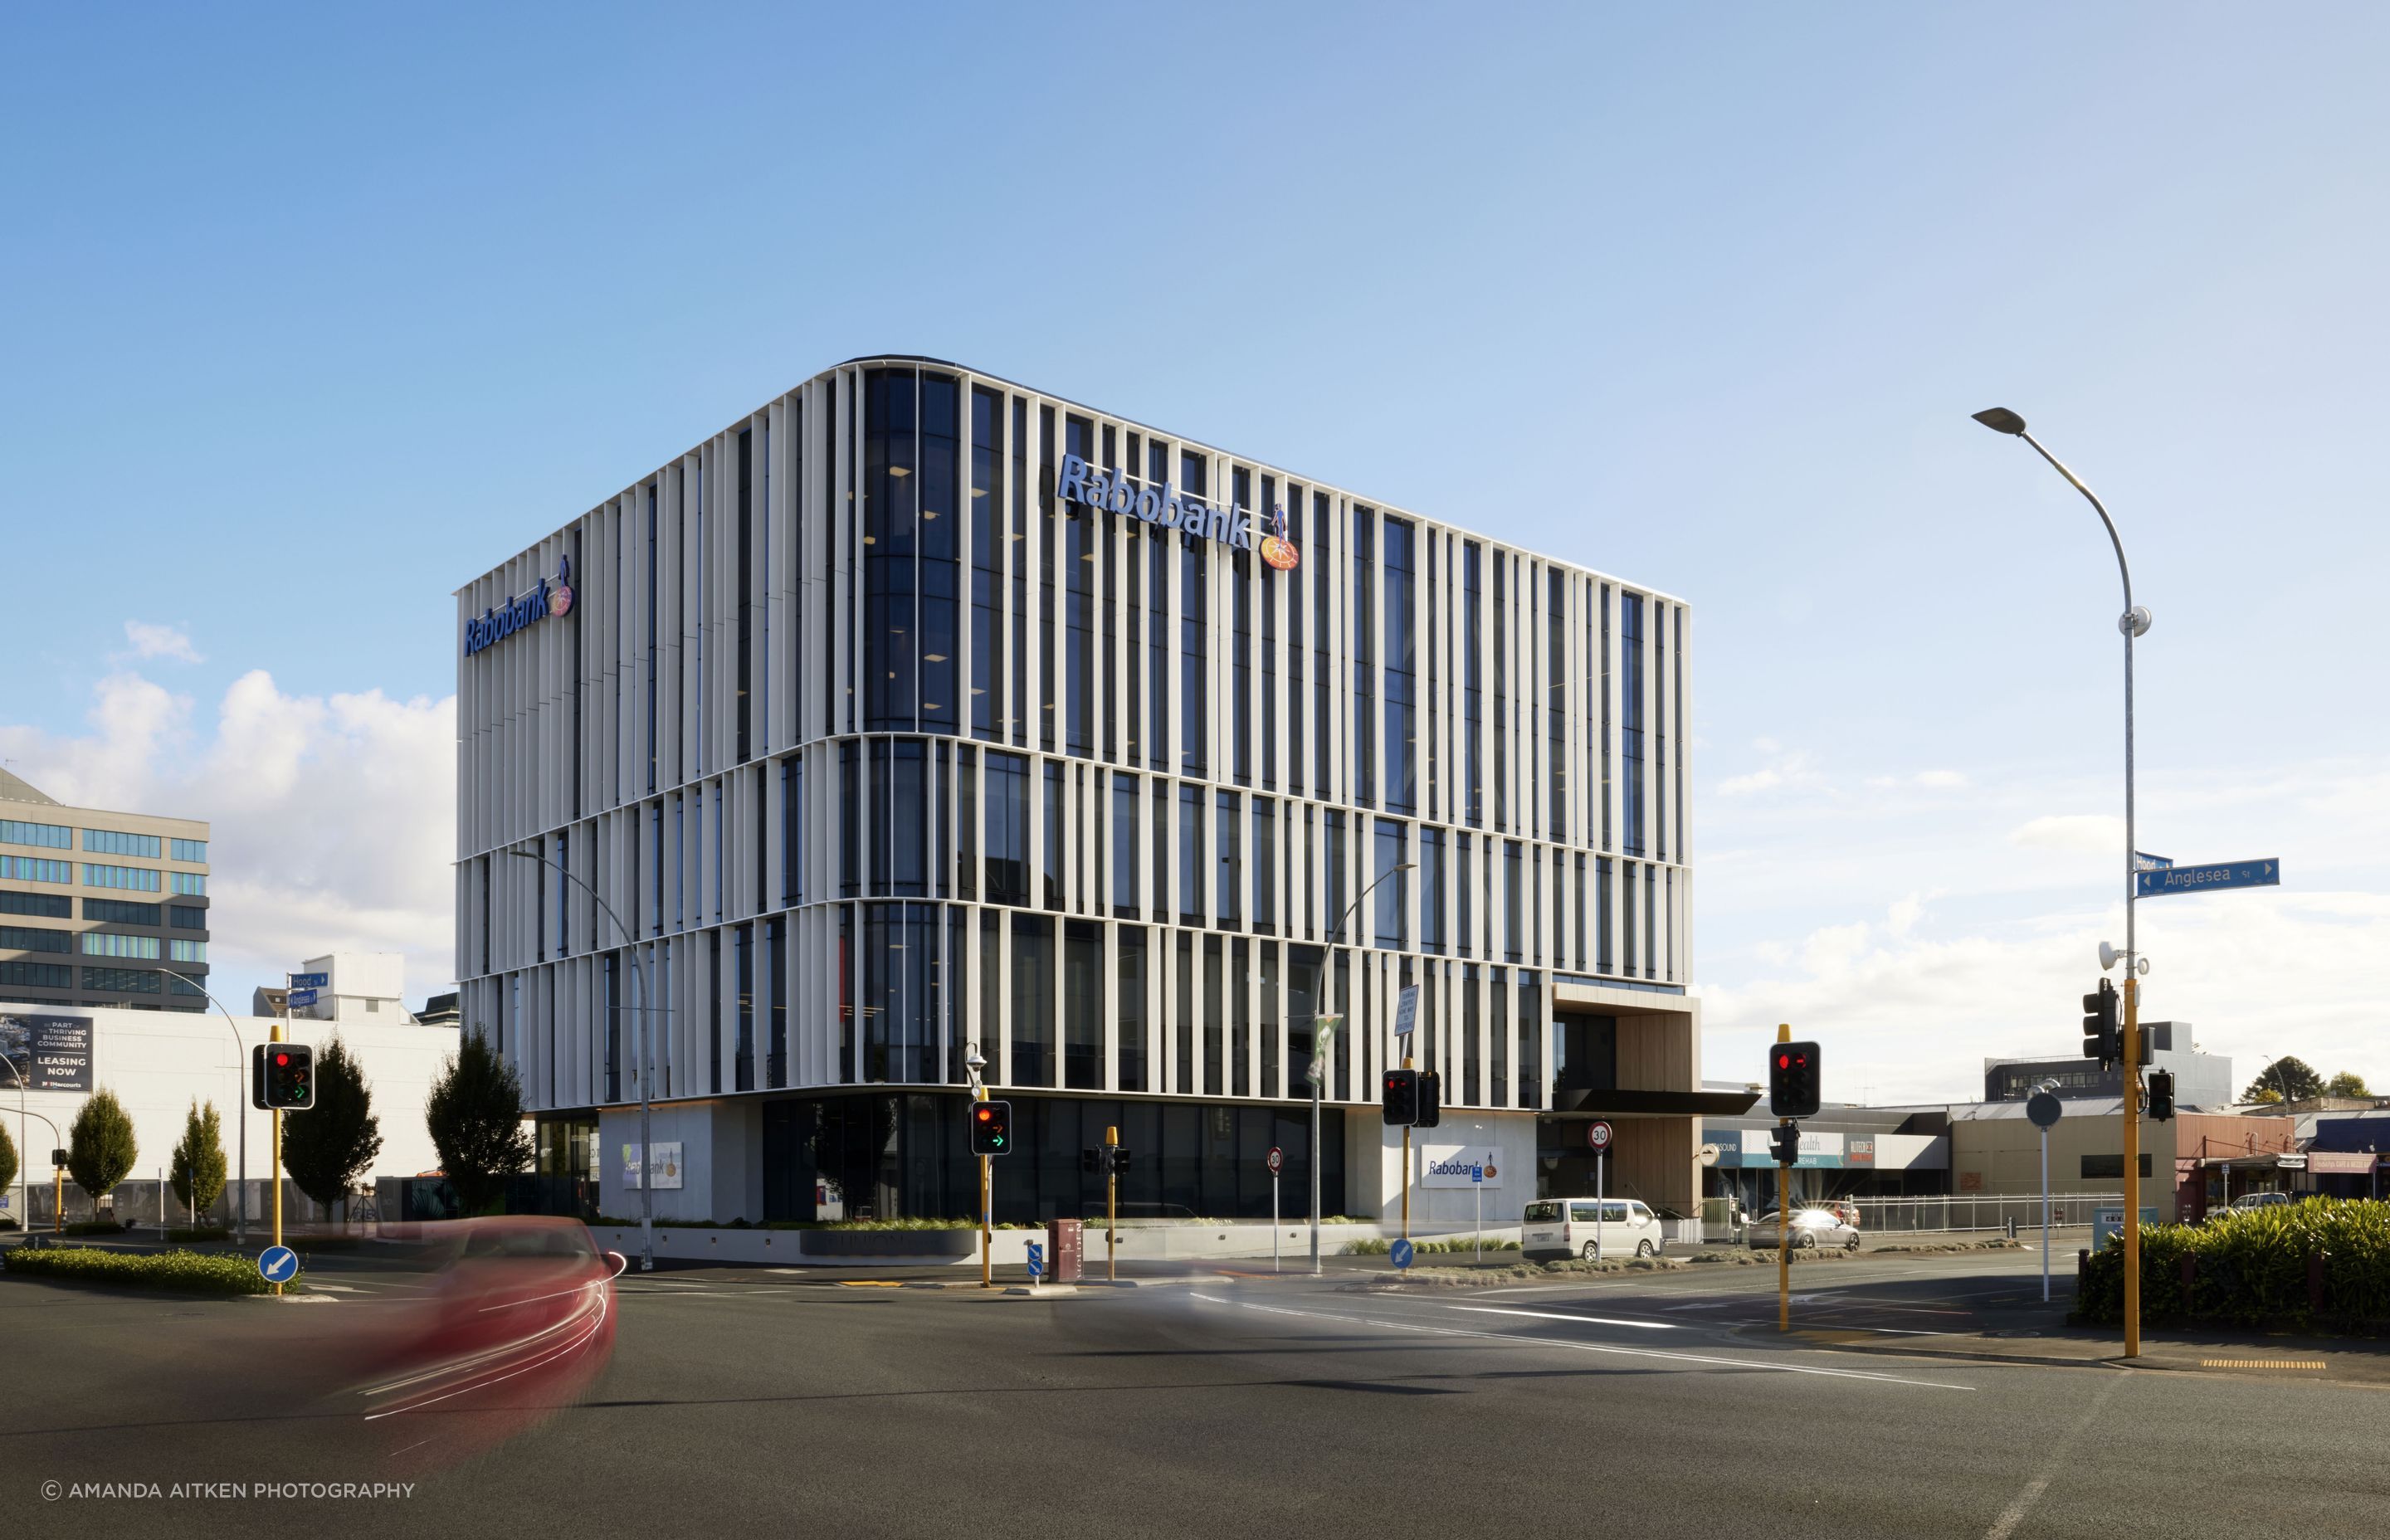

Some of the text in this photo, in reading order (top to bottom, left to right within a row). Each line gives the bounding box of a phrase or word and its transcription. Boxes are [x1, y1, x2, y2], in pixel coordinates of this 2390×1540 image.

[1057, 454, 1251, 549] Rabobank
[464, 578, 551, 658] Rabobank
[2164, 869, 2251, 888] Anglesea St
[293, 975, 312, 987] Hood
[37, 1056, 86, 1066] LEASING
[47, 1067, 76, 1076] NOW
[1593, 1130, 1607, 1141] 30
[1271, 1155, 1280, 1164] 30
[1798, 1157, 1817, 1165] REHAB
